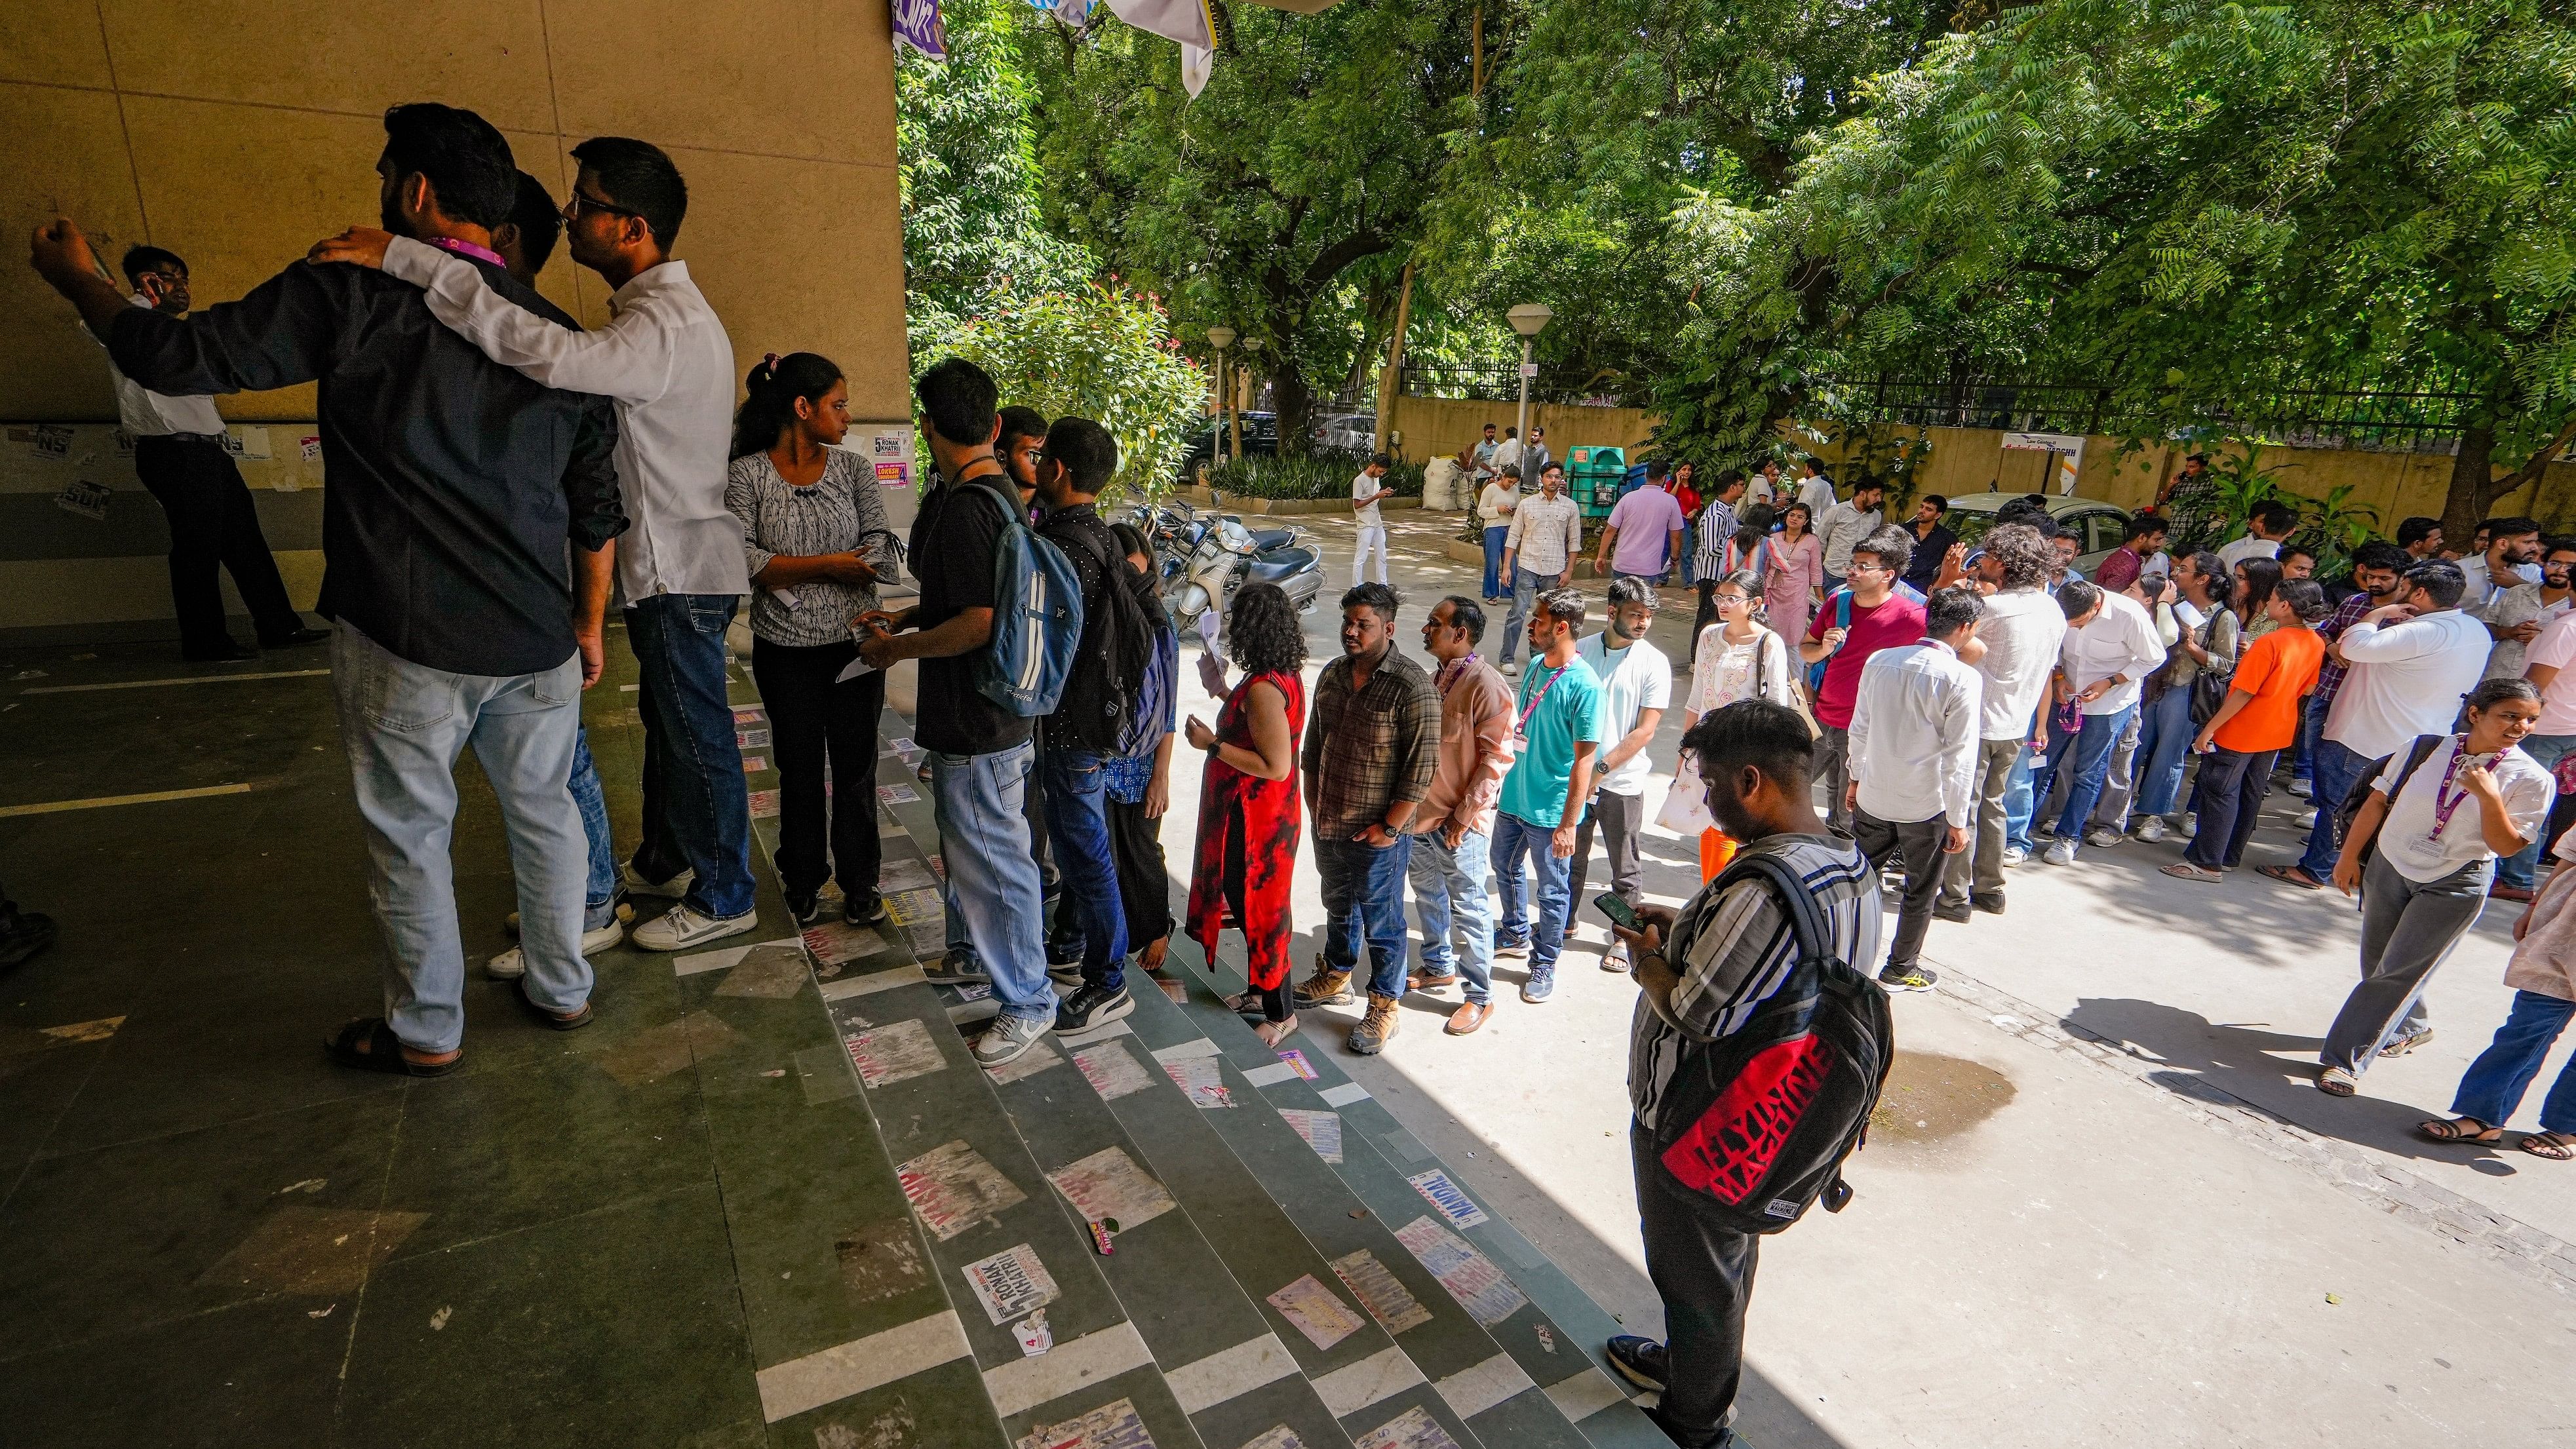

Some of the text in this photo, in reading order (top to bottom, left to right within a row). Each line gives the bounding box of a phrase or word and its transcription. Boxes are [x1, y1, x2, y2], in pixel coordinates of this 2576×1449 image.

[875, 437, 881, 452] 5
[1005, 689, 1033, 702] ArcticFox
[878, 1122, 907, 1138] LOKESH 4
[1694, 1083, 1786, 1170] FLYIN
[1709, 1039, 1837, 1205] MACHINE
[1422, 1175, 1479, 1219] NANDAL
[981, 1262, 1017, 1302] RONAK
[1026, 1338, 1036, 1347] 4
